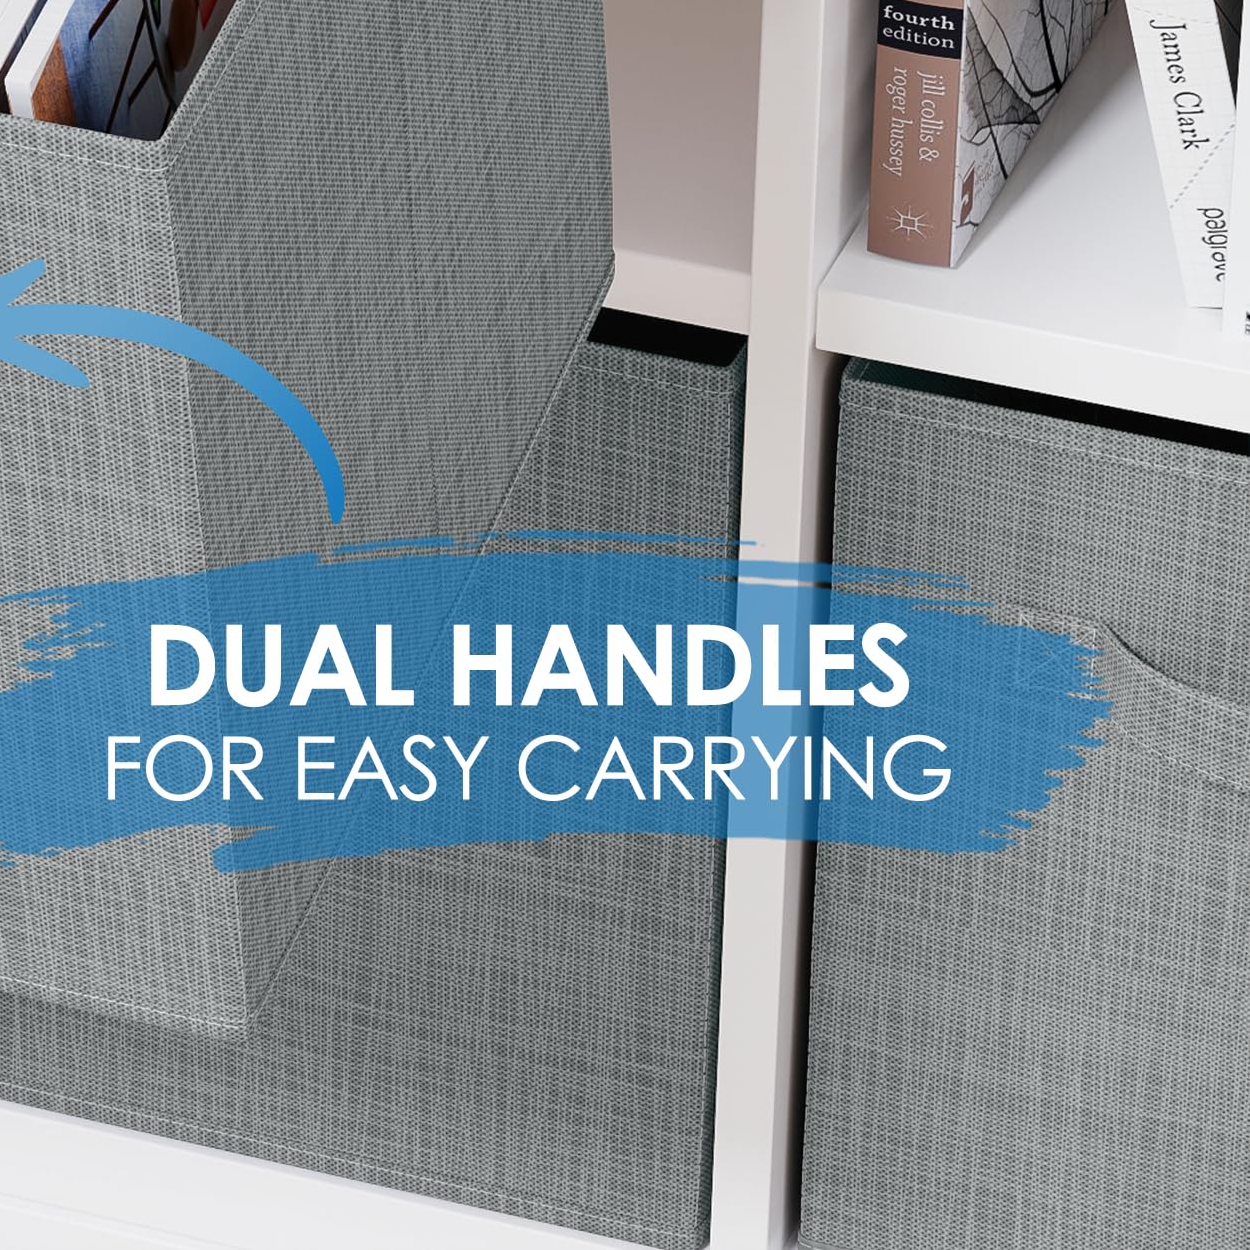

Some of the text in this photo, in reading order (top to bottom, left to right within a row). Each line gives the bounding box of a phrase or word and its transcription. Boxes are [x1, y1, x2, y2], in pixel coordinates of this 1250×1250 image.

[882, 26, 956, 49] edition
[883, 5, 956, 31] fourth
[882, 66, 913, 177] roger hussey
[917, 70, 946, 162] jill collis &
[1149, 19, 1187, 84] James
[1173, 91, 1210, 150] Clark
